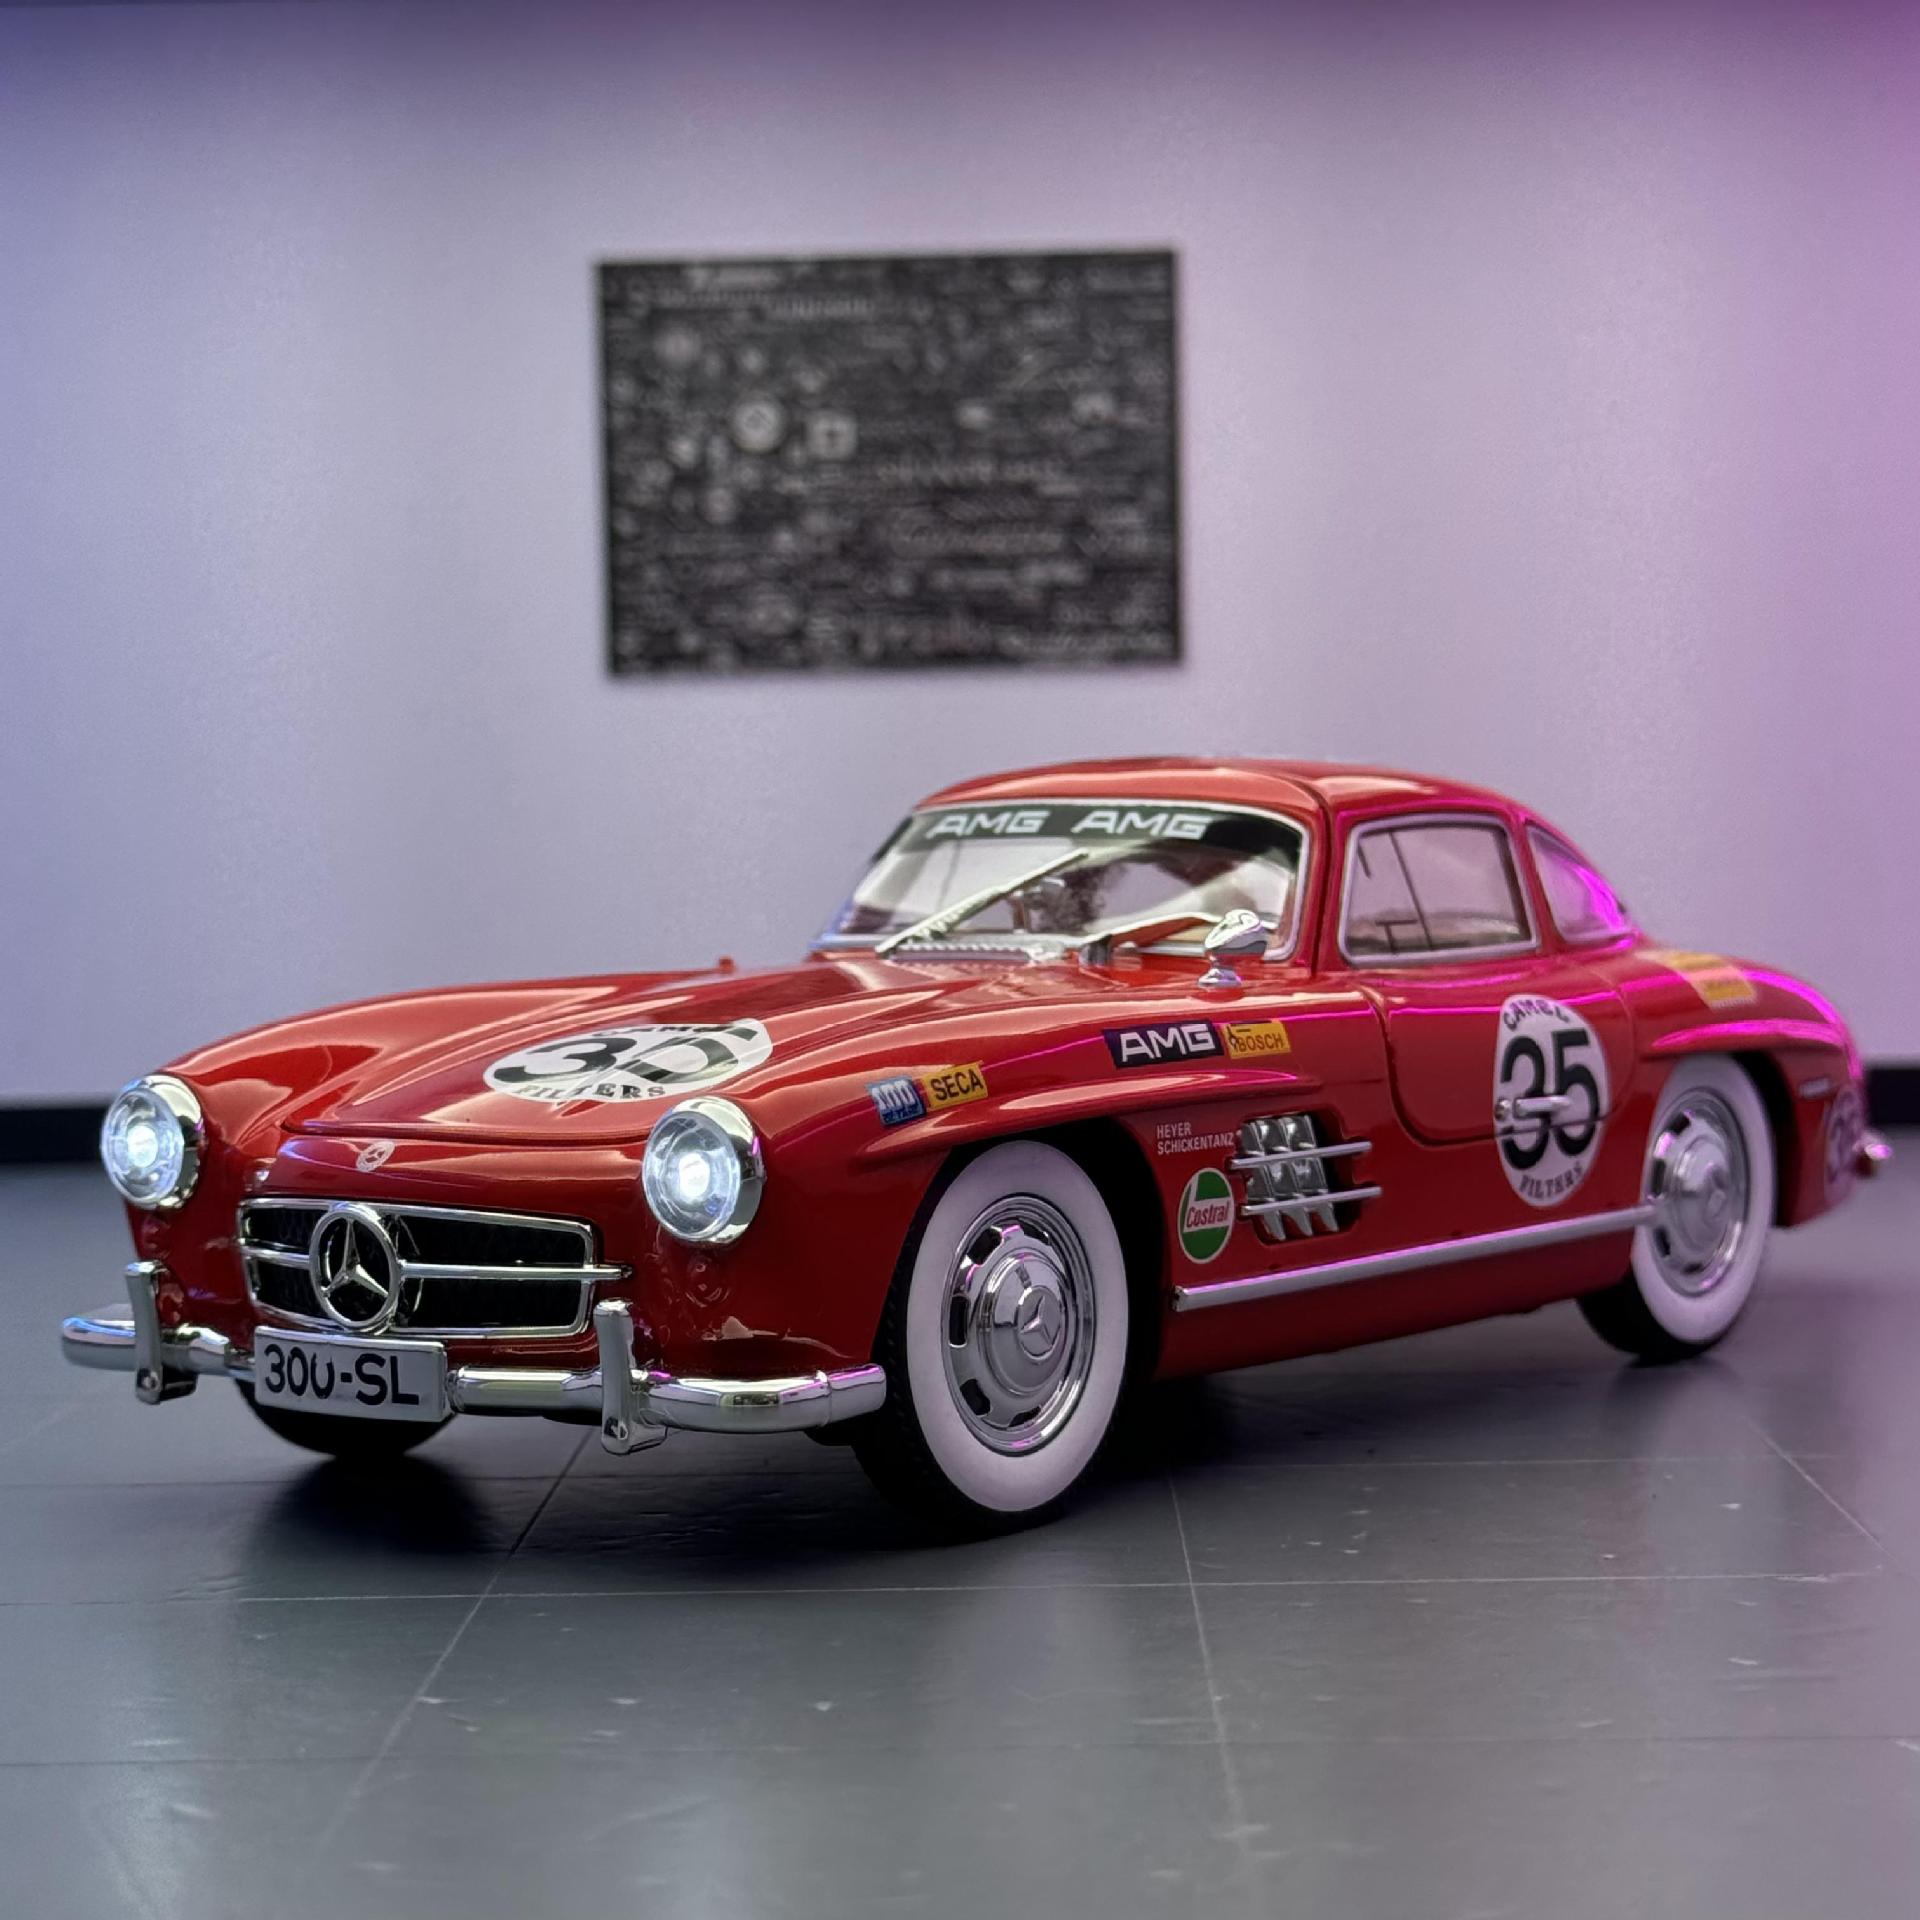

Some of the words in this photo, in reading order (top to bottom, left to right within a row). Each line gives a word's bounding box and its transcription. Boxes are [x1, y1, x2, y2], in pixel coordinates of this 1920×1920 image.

[926, 811, 1049, 839] AMG
[1070, 811, 1213, 840] AMG
[1119, 1023, 1216, 1063] AMG
[1238, 1033, 1285, 1051] BOSCH
[930, 1069, 984, 1101] SECA
[1500, 1028, 1600, 1170] 35
[1156, 1122, 1192, 1139] HEYER
[1157, 1132, 1235, 1155] SCHICKENTANZ
